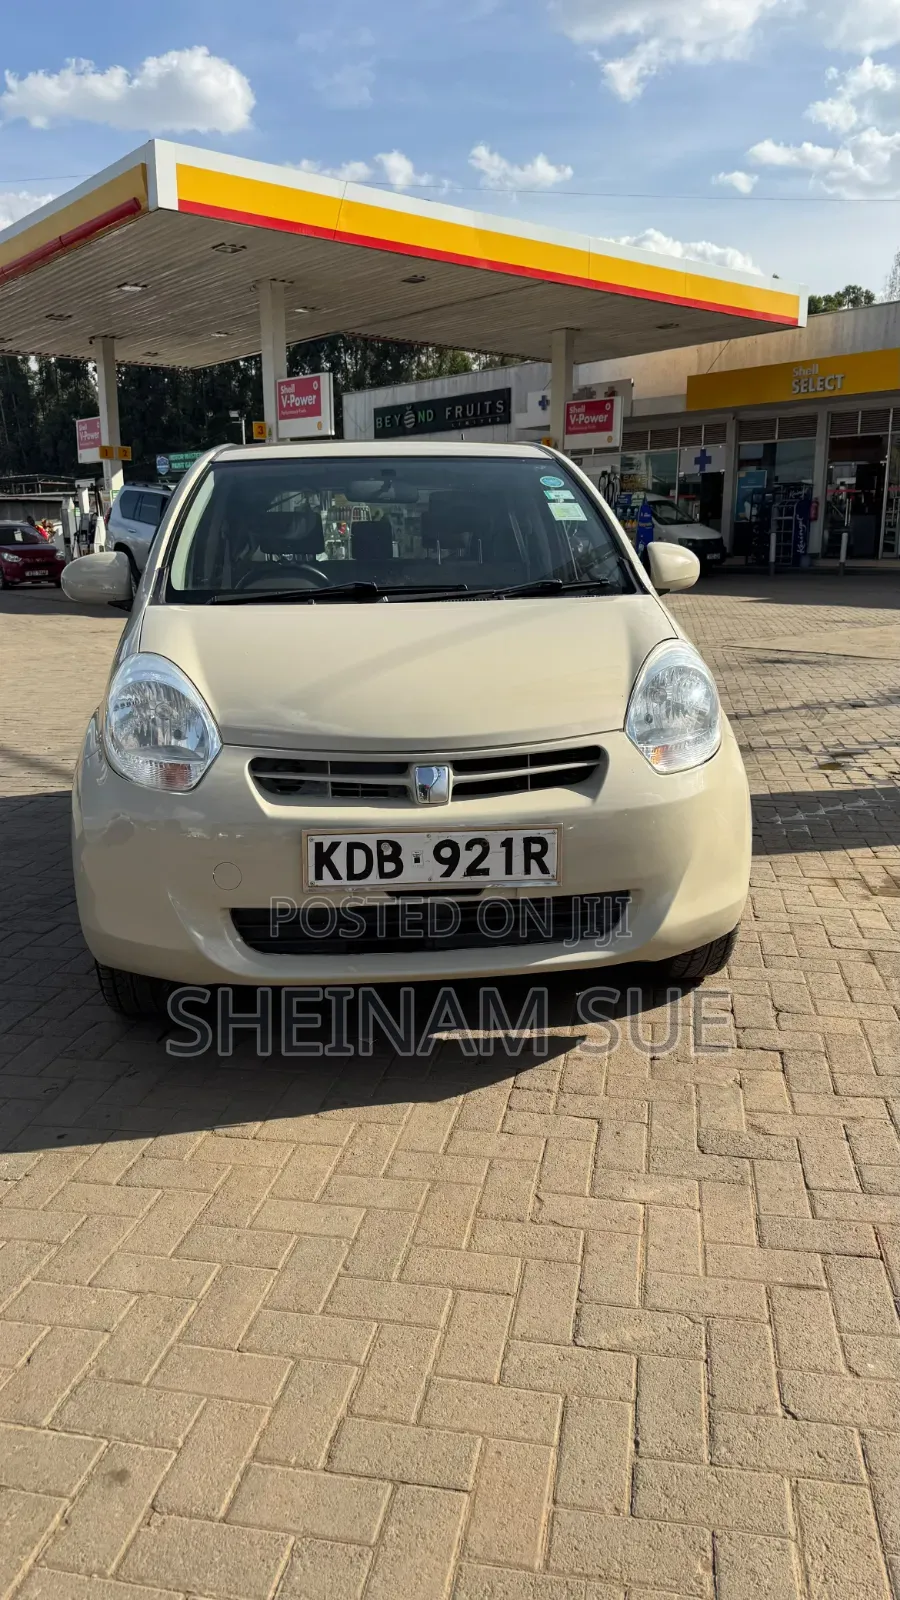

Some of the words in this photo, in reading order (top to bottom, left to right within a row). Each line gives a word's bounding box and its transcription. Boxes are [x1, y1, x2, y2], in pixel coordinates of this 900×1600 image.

[792, 363, 819, 377] Shell
[280, 383, 296, 395] Shell
[791, 373, 845, 394] SELECT
[280, 394, 317, 409] V-Power
[445, 399, 505, 420] FRUITS
[568, 403, 586, 414] Shell
[451, 416, 501, 428] LIMITED
[568, 413, 609, 425] V-Power
[256, 425, 265, 436] 3
[122, 449, 129, 457] 2
[313, 837, 404, 881] KDB
[432, 836, 551, 879] 921R
